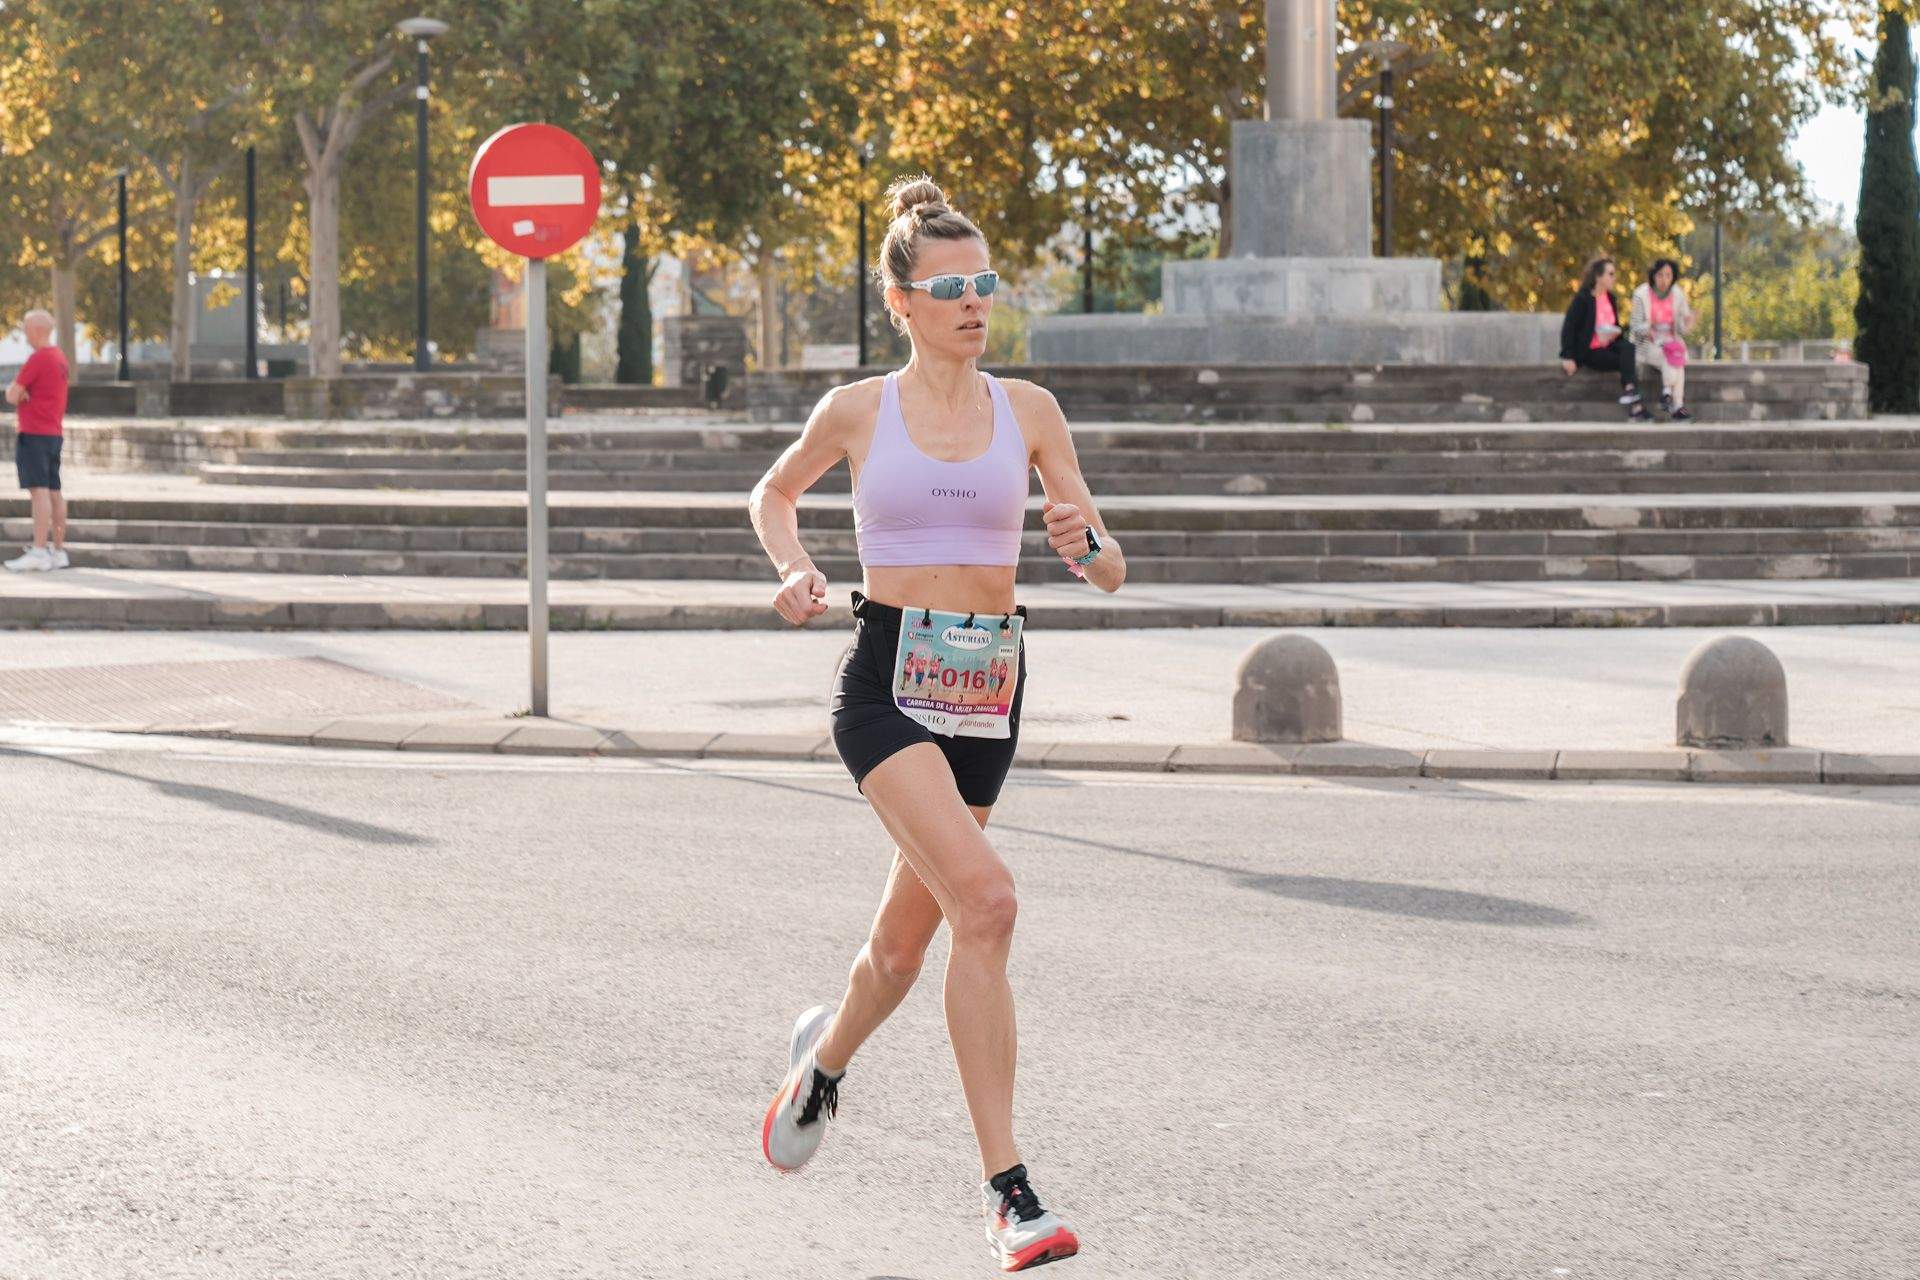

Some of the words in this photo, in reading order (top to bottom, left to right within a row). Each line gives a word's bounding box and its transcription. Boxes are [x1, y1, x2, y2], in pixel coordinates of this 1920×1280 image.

[931, 488, 976, 498] OYSHO
[941, 668, 986, 689] 016
[906, 699, 934, 708] CARRERA
[935, 701, 945, 710] DE
[945, 703, 953, 712] LA
